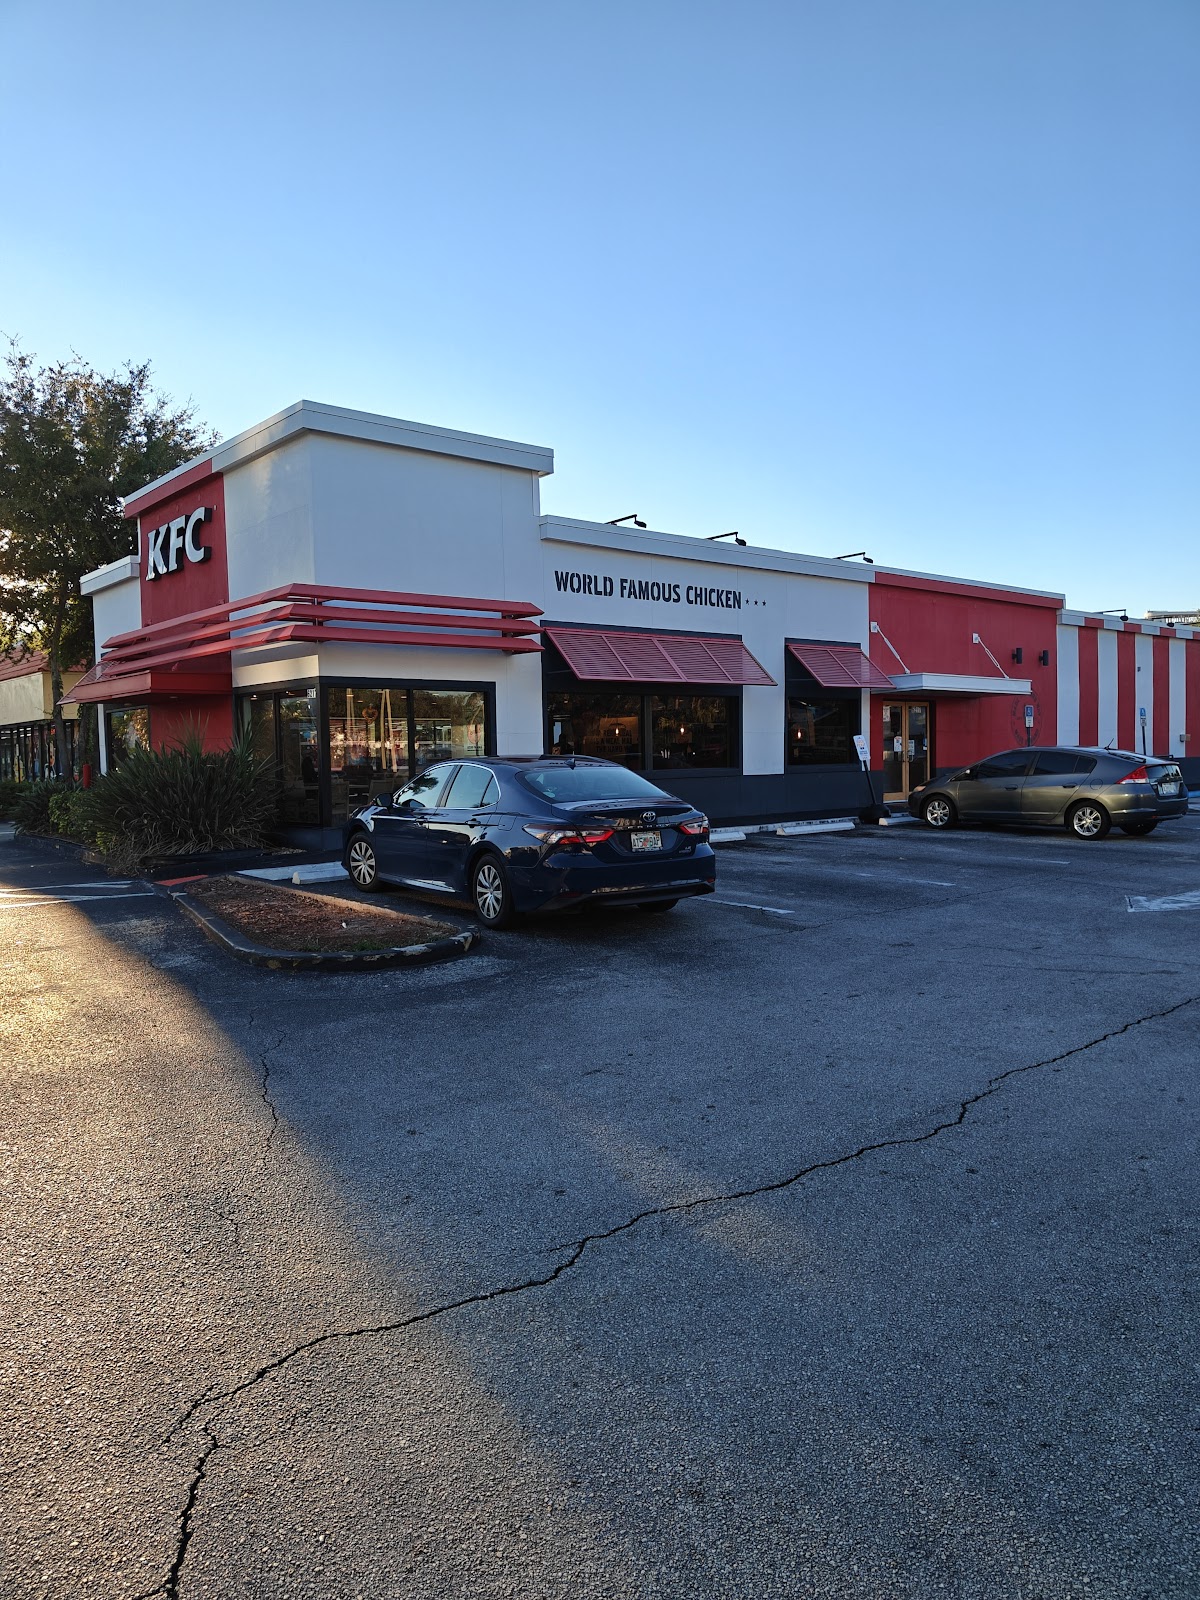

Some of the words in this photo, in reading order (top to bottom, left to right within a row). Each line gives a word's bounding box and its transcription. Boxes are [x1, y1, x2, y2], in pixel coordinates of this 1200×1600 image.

[145, 506, 211, 581] KFC
[554, 570, 614, 597] WORLD
[619, 578, 681, 603] FAMOUS
[685, 585, 742, 609] CHICKEN
